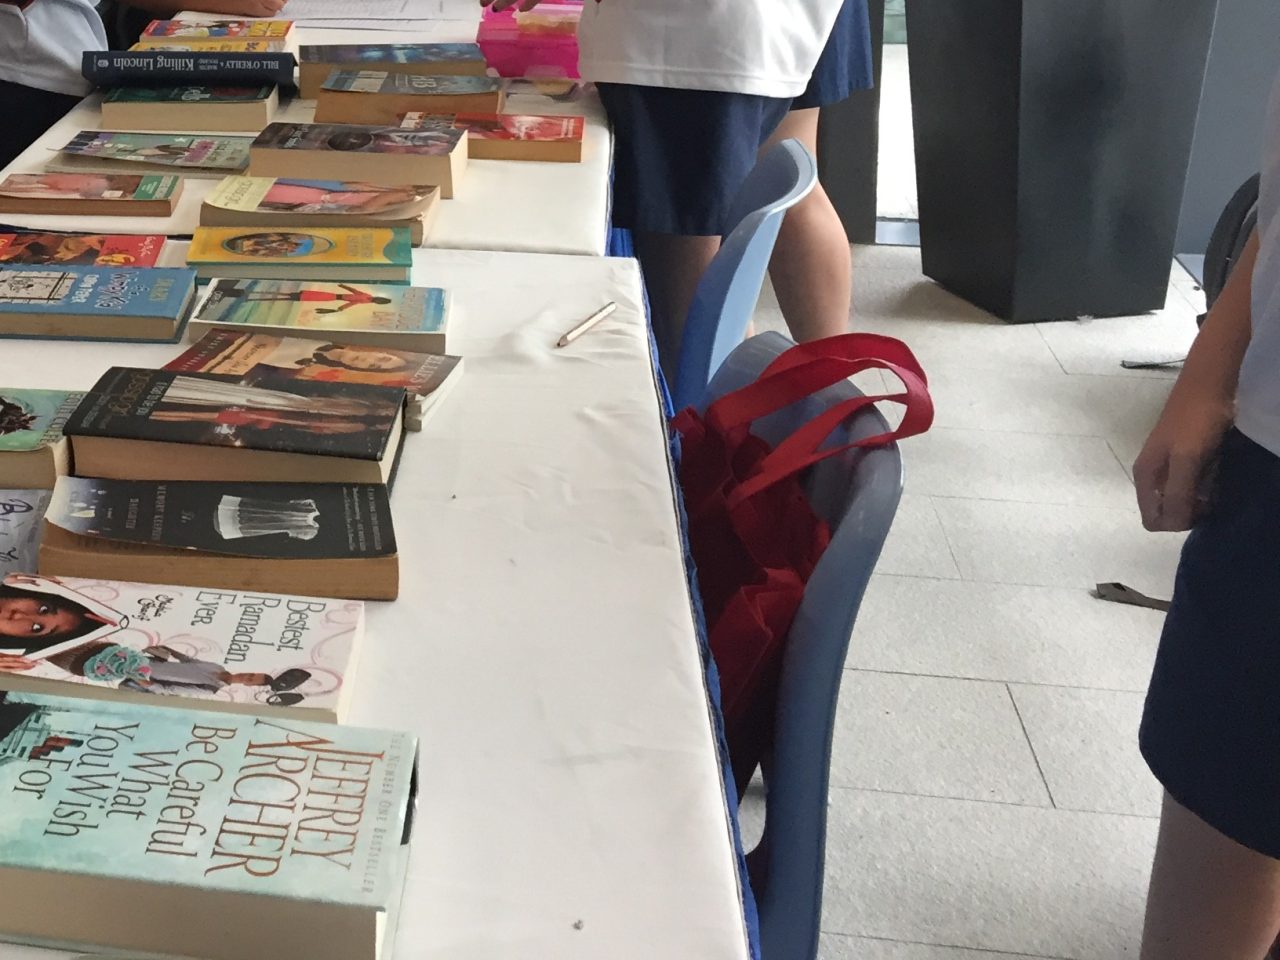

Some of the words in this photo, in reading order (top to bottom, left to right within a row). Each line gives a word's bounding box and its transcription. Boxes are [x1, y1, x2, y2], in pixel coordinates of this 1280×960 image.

[113, 57, 154, 71] Lincoln
[157, 55, 194, 72] Killing
[76, 722, 141, 769] You
[185, 723, 237, 754] Be
[12, 756, 74, 801] For
[106, 749, 180, 821] What
[204, 718, 335, 878] ARCHER
[380, 754, 399, 795] NUMBER
[43, 771, 119, 838] Wish
[145, 758, 224, 858] Careful
[286, 738, 385, 872] JEFFREY
[360, 826, 385, 894] BESTSELLER
